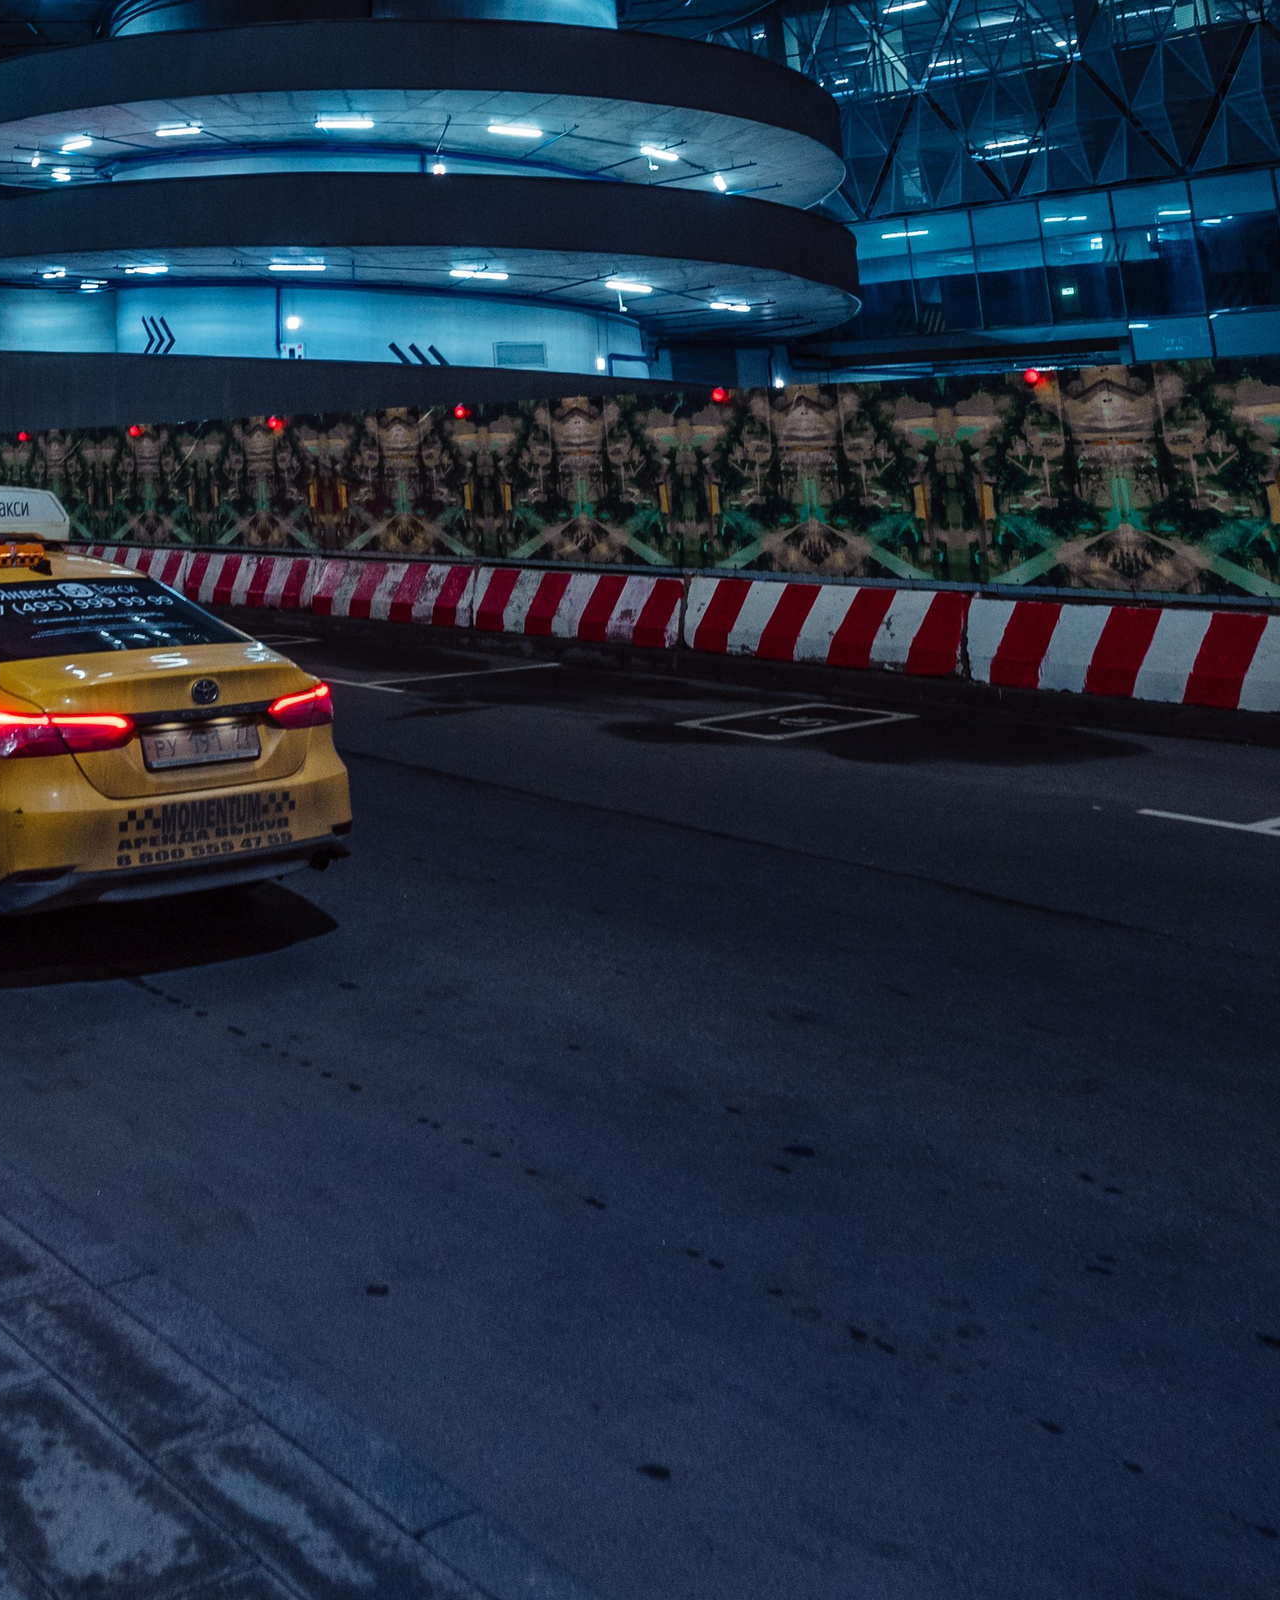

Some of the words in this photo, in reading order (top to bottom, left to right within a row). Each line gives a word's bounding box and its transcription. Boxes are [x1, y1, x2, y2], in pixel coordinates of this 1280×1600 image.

[88, 583, 140, 596] Такси
[11, 599, 73, 616] (495)
[73, 597, 117, 610] 999
[117, 595, 146, 607] 99
[147, 595, 174, 606] 99
[162, 792, 262, 833] MOMENTUM
[118, 829, 210, 851] АРЕНДА
